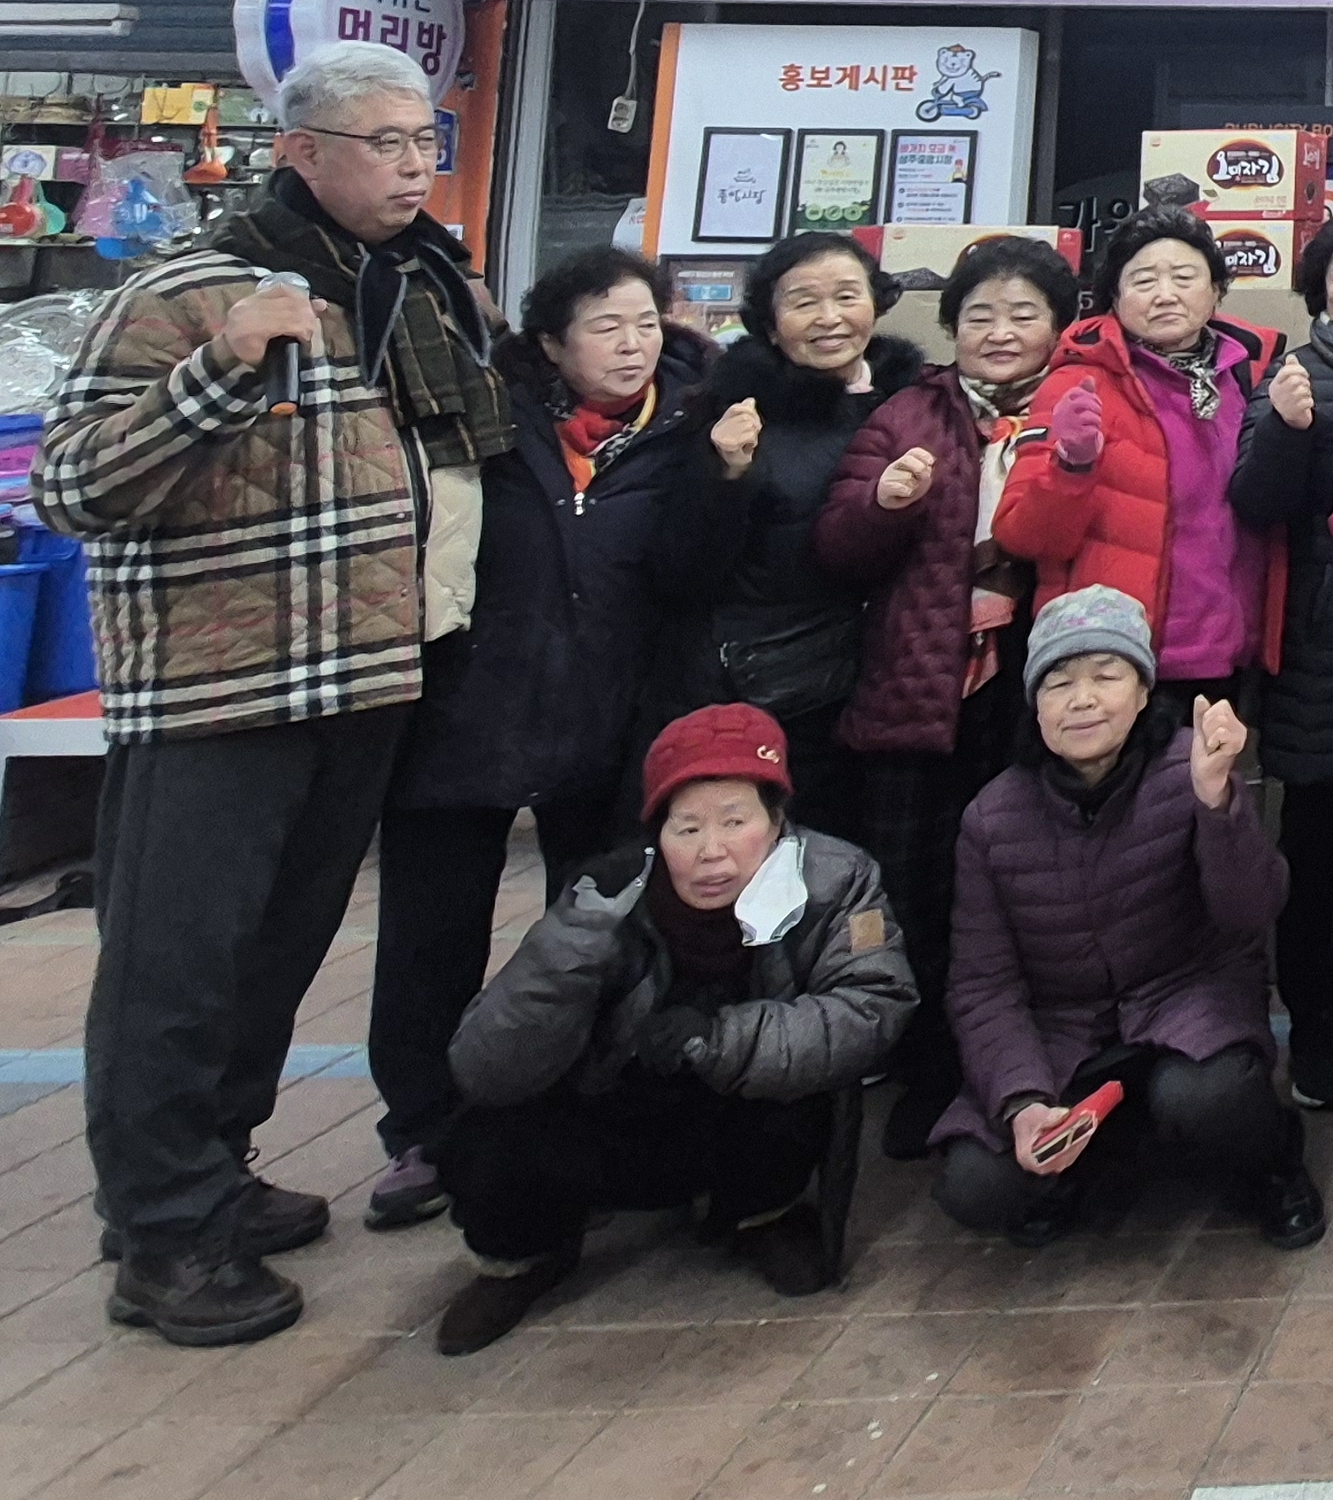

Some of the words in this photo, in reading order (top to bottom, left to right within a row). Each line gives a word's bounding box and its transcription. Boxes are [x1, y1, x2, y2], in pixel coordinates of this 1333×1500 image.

[338, 7, 447, 76] 머리방
[779, 63, 918, 92] 홍보게시판
[1213, 150, 1280, 184] 오미자김
[1216, 240, 1277, 274] 미자김
